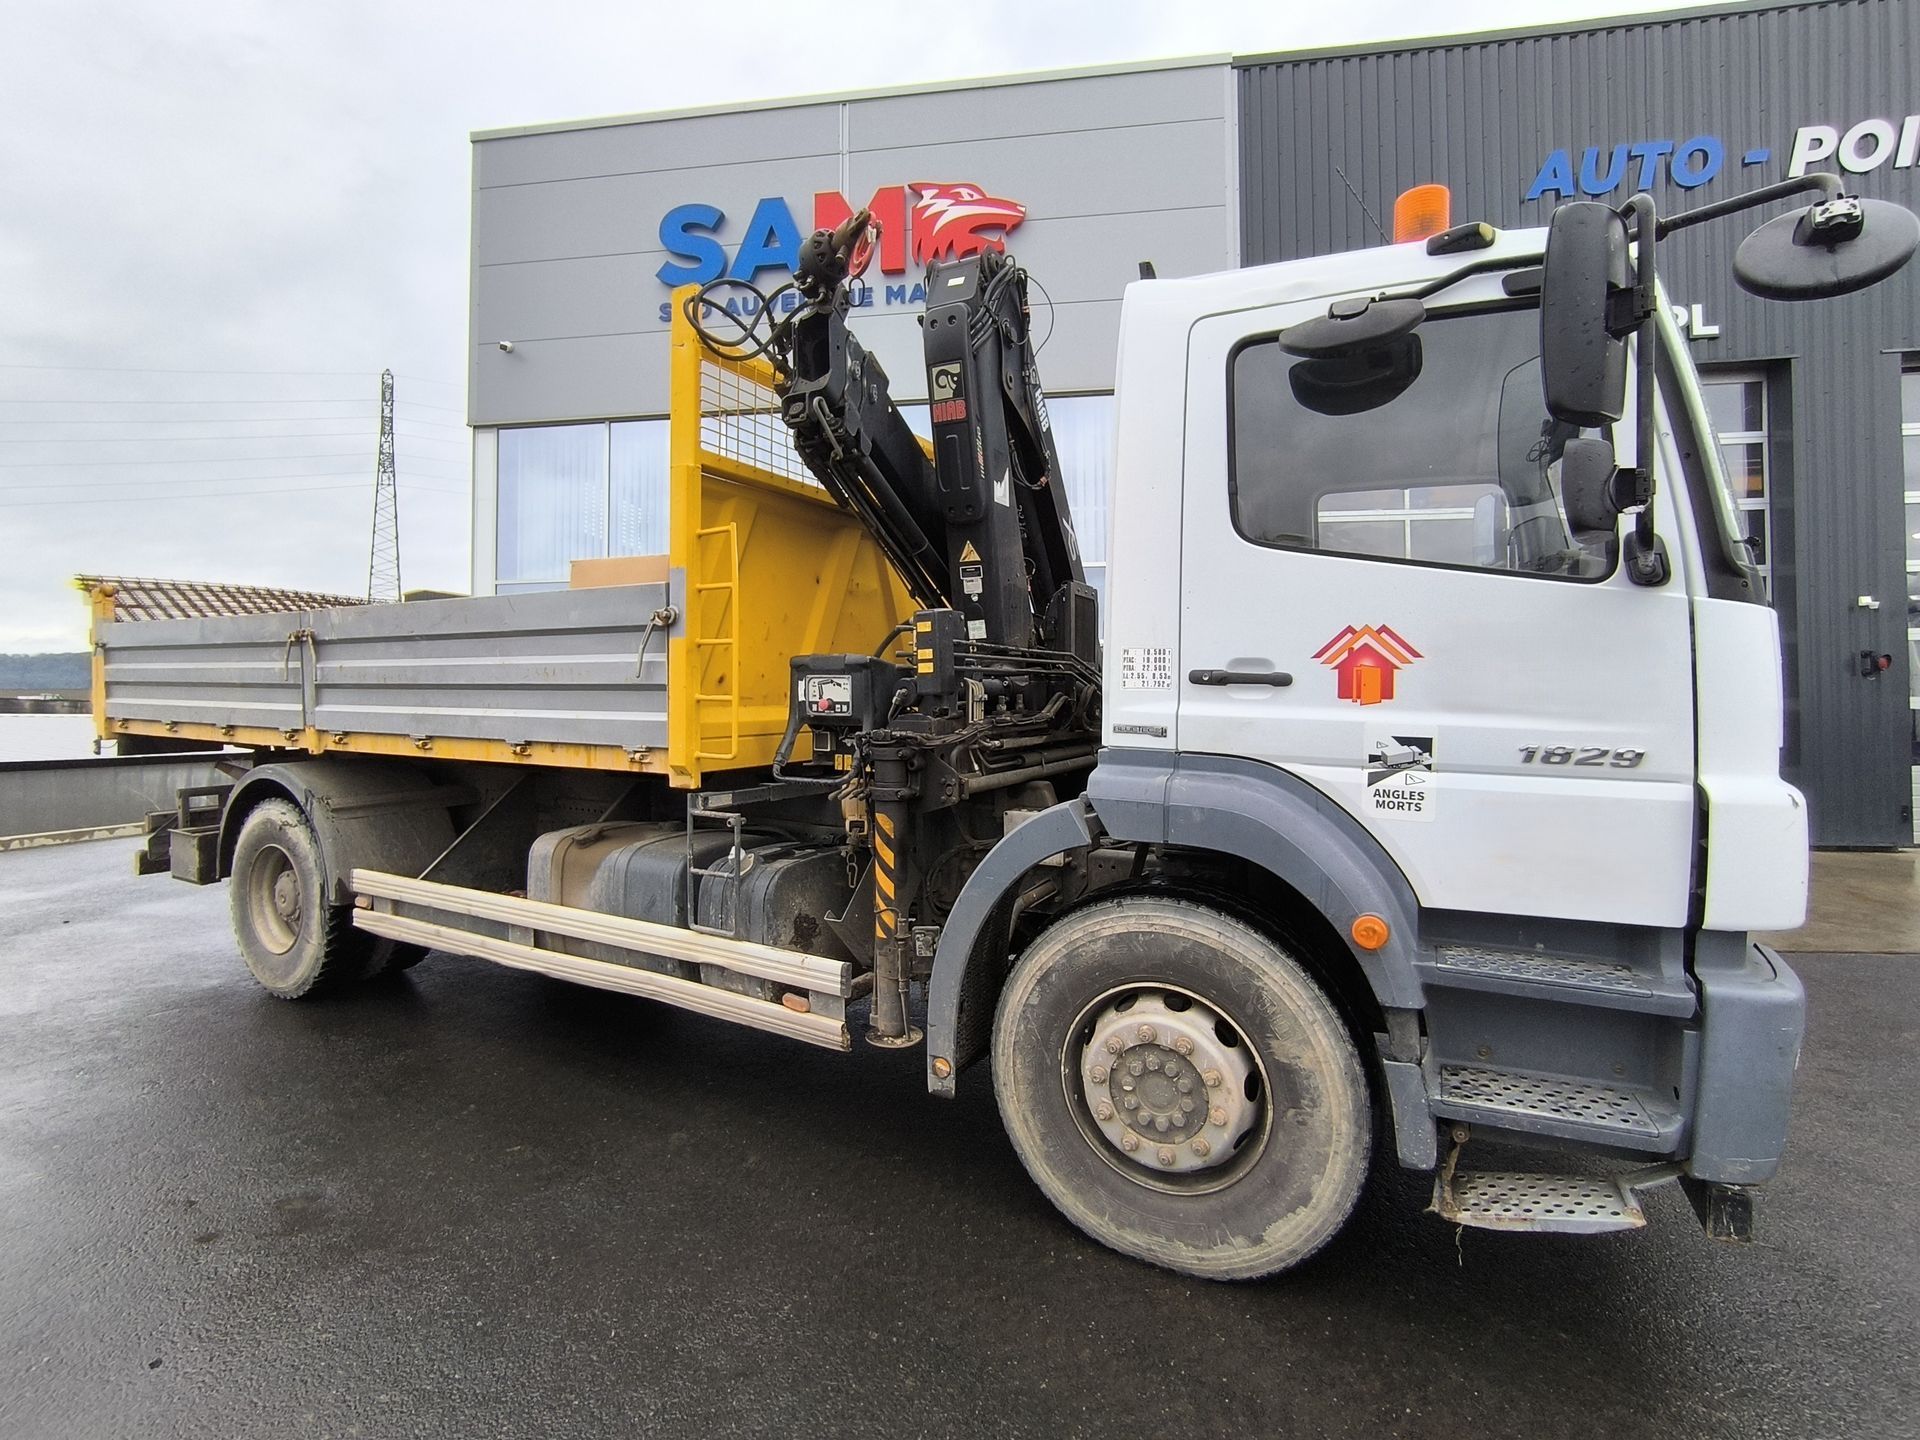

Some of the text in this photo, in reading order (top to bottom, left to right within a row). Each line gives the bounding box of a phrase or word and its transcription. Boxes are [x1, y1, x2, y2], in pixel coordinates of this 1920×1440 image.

[1525, 136, 1725, 200] AUTO
[1787, 114, 1920, 178] POI
[655, 185, 906, 288] SAM
[932, 399, 967, 423] HIAB
[1034, 387, 1050, 433] HIAB
[1518, 743, 1646, 768] 1829
[1373, 788, 1425, 801] ANGLES
[1375, 799, 1422, 812] MORTS
